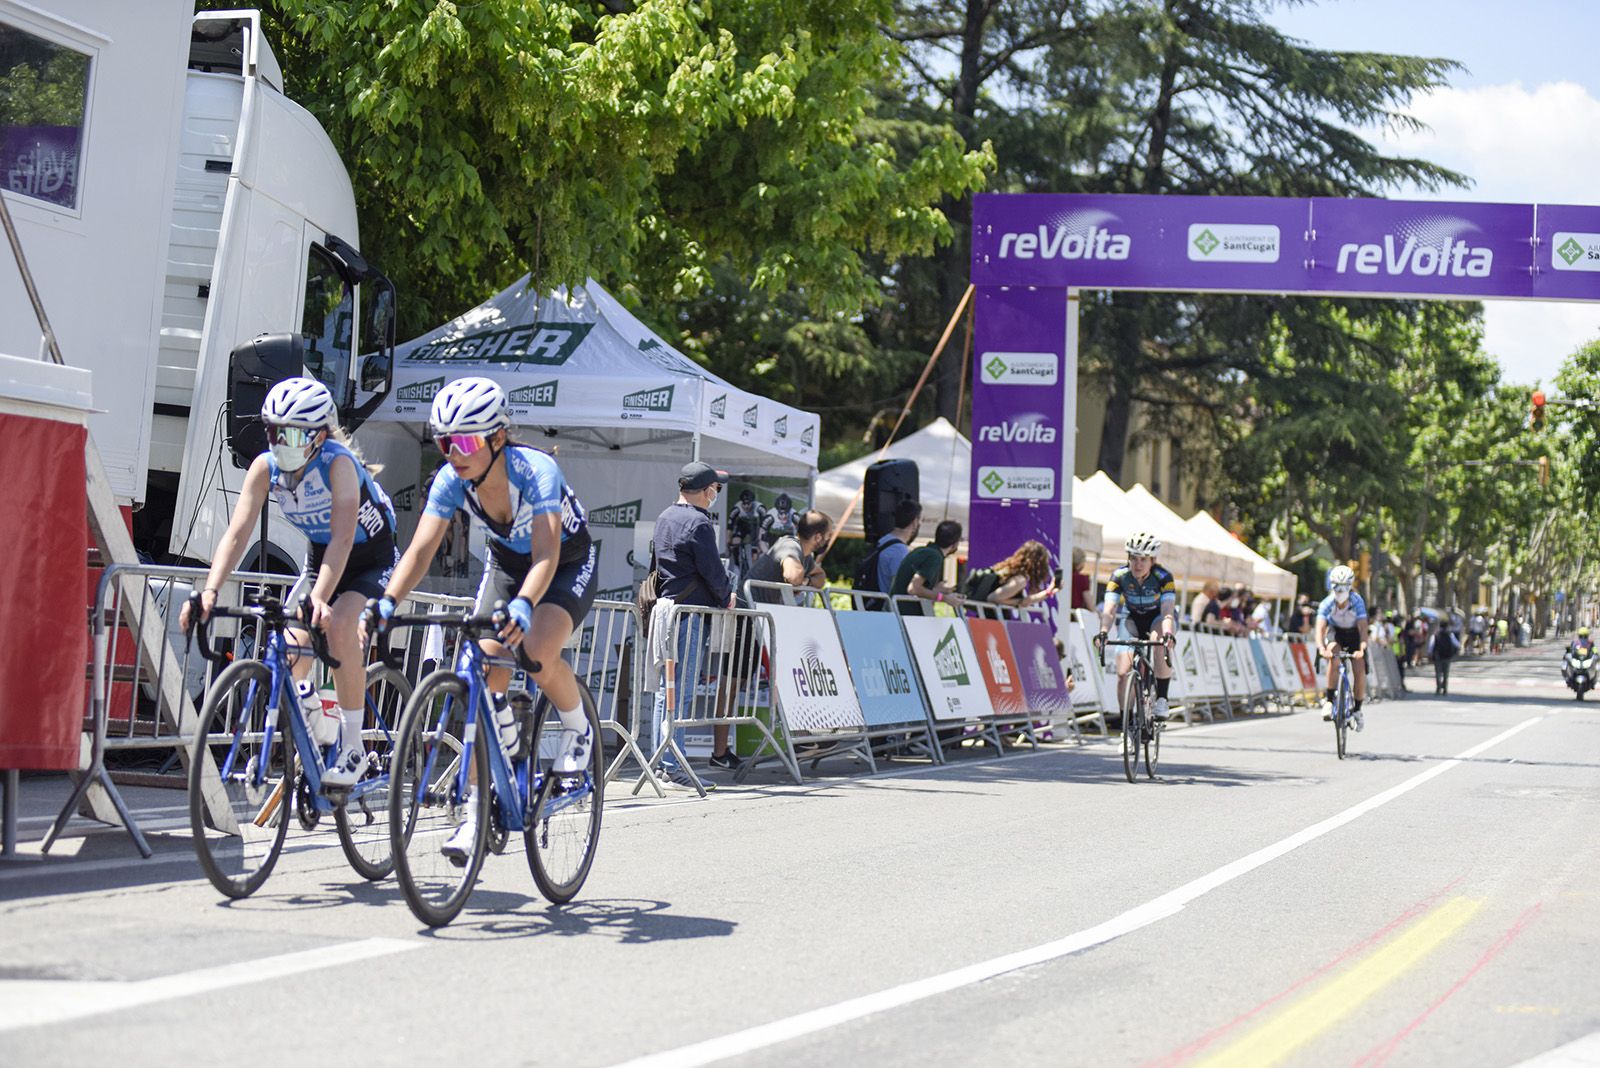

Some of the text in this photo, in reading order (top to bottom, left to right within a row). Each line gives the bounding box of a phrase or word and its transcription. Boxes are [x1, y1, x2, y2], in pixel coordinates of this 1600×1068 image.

[999, 225, 1131, 260] reVolta
[1223, 242, 1276, 252] SantCugat
[1336, 235, 1493, 277] reVolta
[413, 328, 572, 361] FINISHER
[1011, 367, 1054, 377] SantCugat
[399, 382, 440, 399] FINISHER
[510, 386, 553, 402] FINISHER
[624, 390, 669, 407] FINISHER
[979, 421, 1056, 443] reVolta
[1007, 482, 1051, 491] SantCugat
[357, 499, 384, 537] FARTO
[590, 505, 637, 523] FINISHER
[792, 658, 839, 697] reVolta
